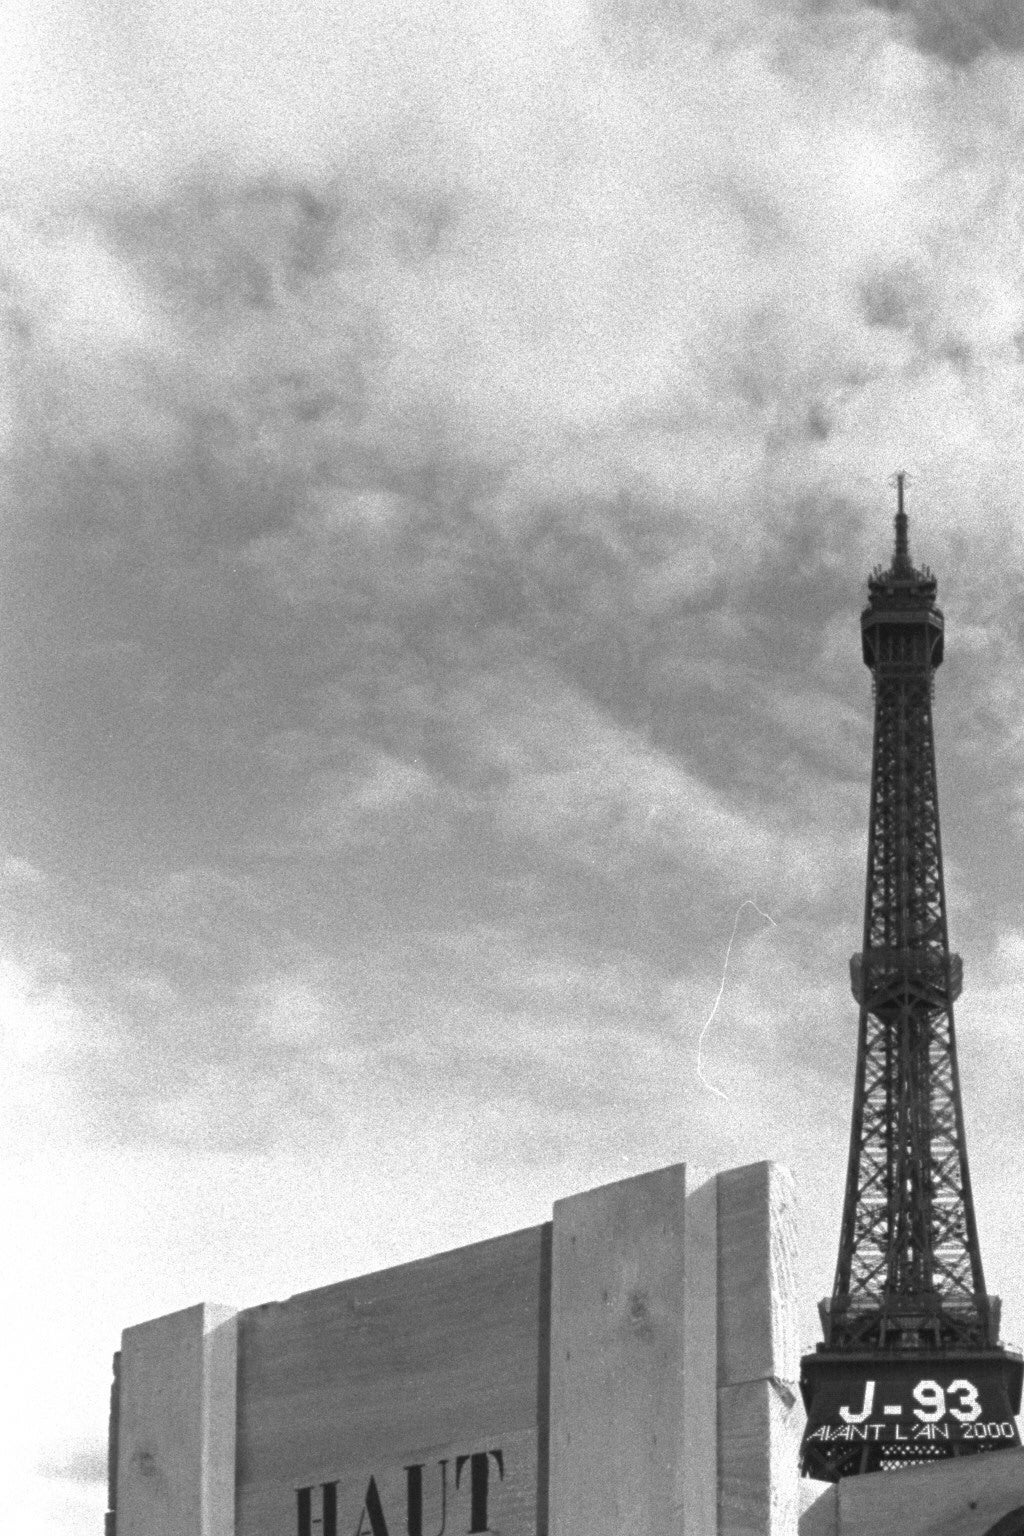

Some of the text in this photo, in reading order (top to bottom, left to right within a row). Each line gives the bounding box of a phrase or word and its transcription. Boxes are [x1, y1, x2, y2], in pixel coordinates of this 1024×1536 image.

[838, 1379, 982, 1423] J-93
[807, 1422, 1015, 1441] AVANT L'AN 2000
